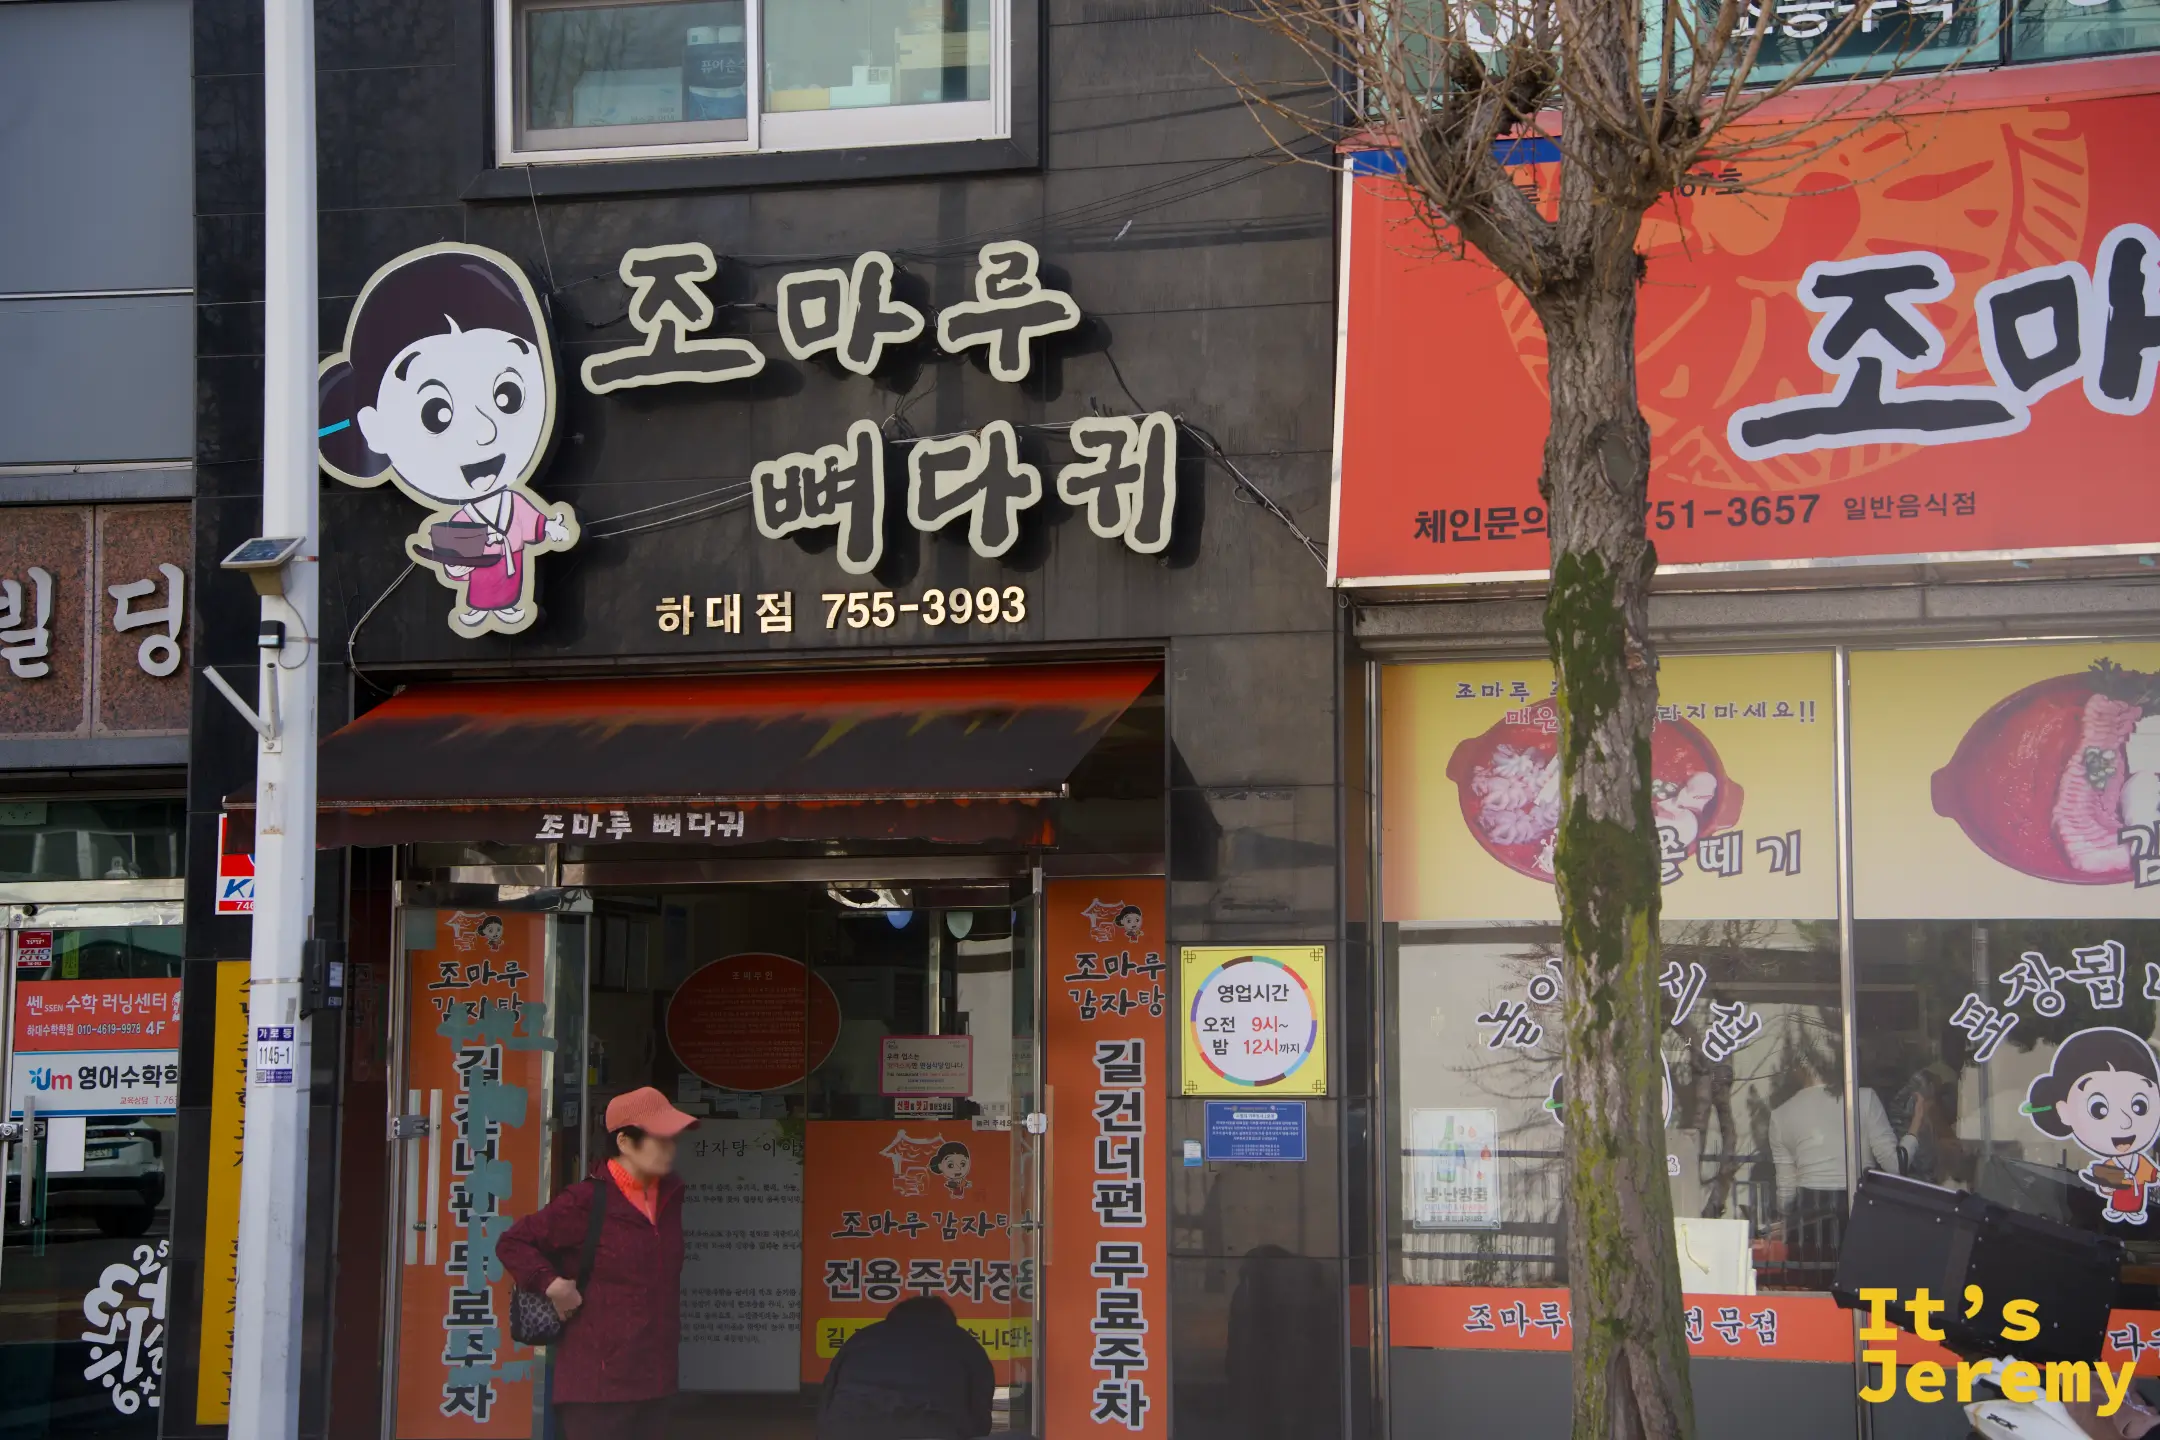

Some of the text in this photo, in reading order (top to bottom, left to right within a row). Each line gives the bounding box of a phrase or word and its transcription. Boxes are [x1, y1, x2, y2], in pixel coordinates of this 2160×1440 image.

[581, 240, 1081, 394] 조마루
[750, 411, 1178, 574] 뼈다귀
[1645, 493, 1821, 532] 51-3657
[1843, 490, 1977, 522] 일반음식점
[655, 586, 1027, 635] 하대점 755-3993
[1455, 681, 1531, 703] 조마루
[535, 809, 633, 840] 조마루
[428, 959, 529, 991] 조마루
[1064, 951, 1166, 983] 조마루
[26, 995, 43, 1016] 쎈
[65, 993, 98, 1015] 수학
[102, 992, 167, 1015] 러닝센터
[1068, 984, 1166, 1021] 감자탕
[1217, 983, 1290, 1003] 영업시간
[145, 1020, 166, 1035] 4F
[258, 1028, 293, 1039] 가로등
[1203, 1015, 1289, 1033] 오전 9시~
[259, 1046, 290, 1065] 1145-1
[1212, 1037, 1300, 1056] 밤 12시까지
[694, 1138, 748, 1158] 감자탕
[831, 1209, 929, 1241] 조마루
[1090, 1241, 1151, 1431] 무료주차
[2107, 1321, 2160, 1363] 다
